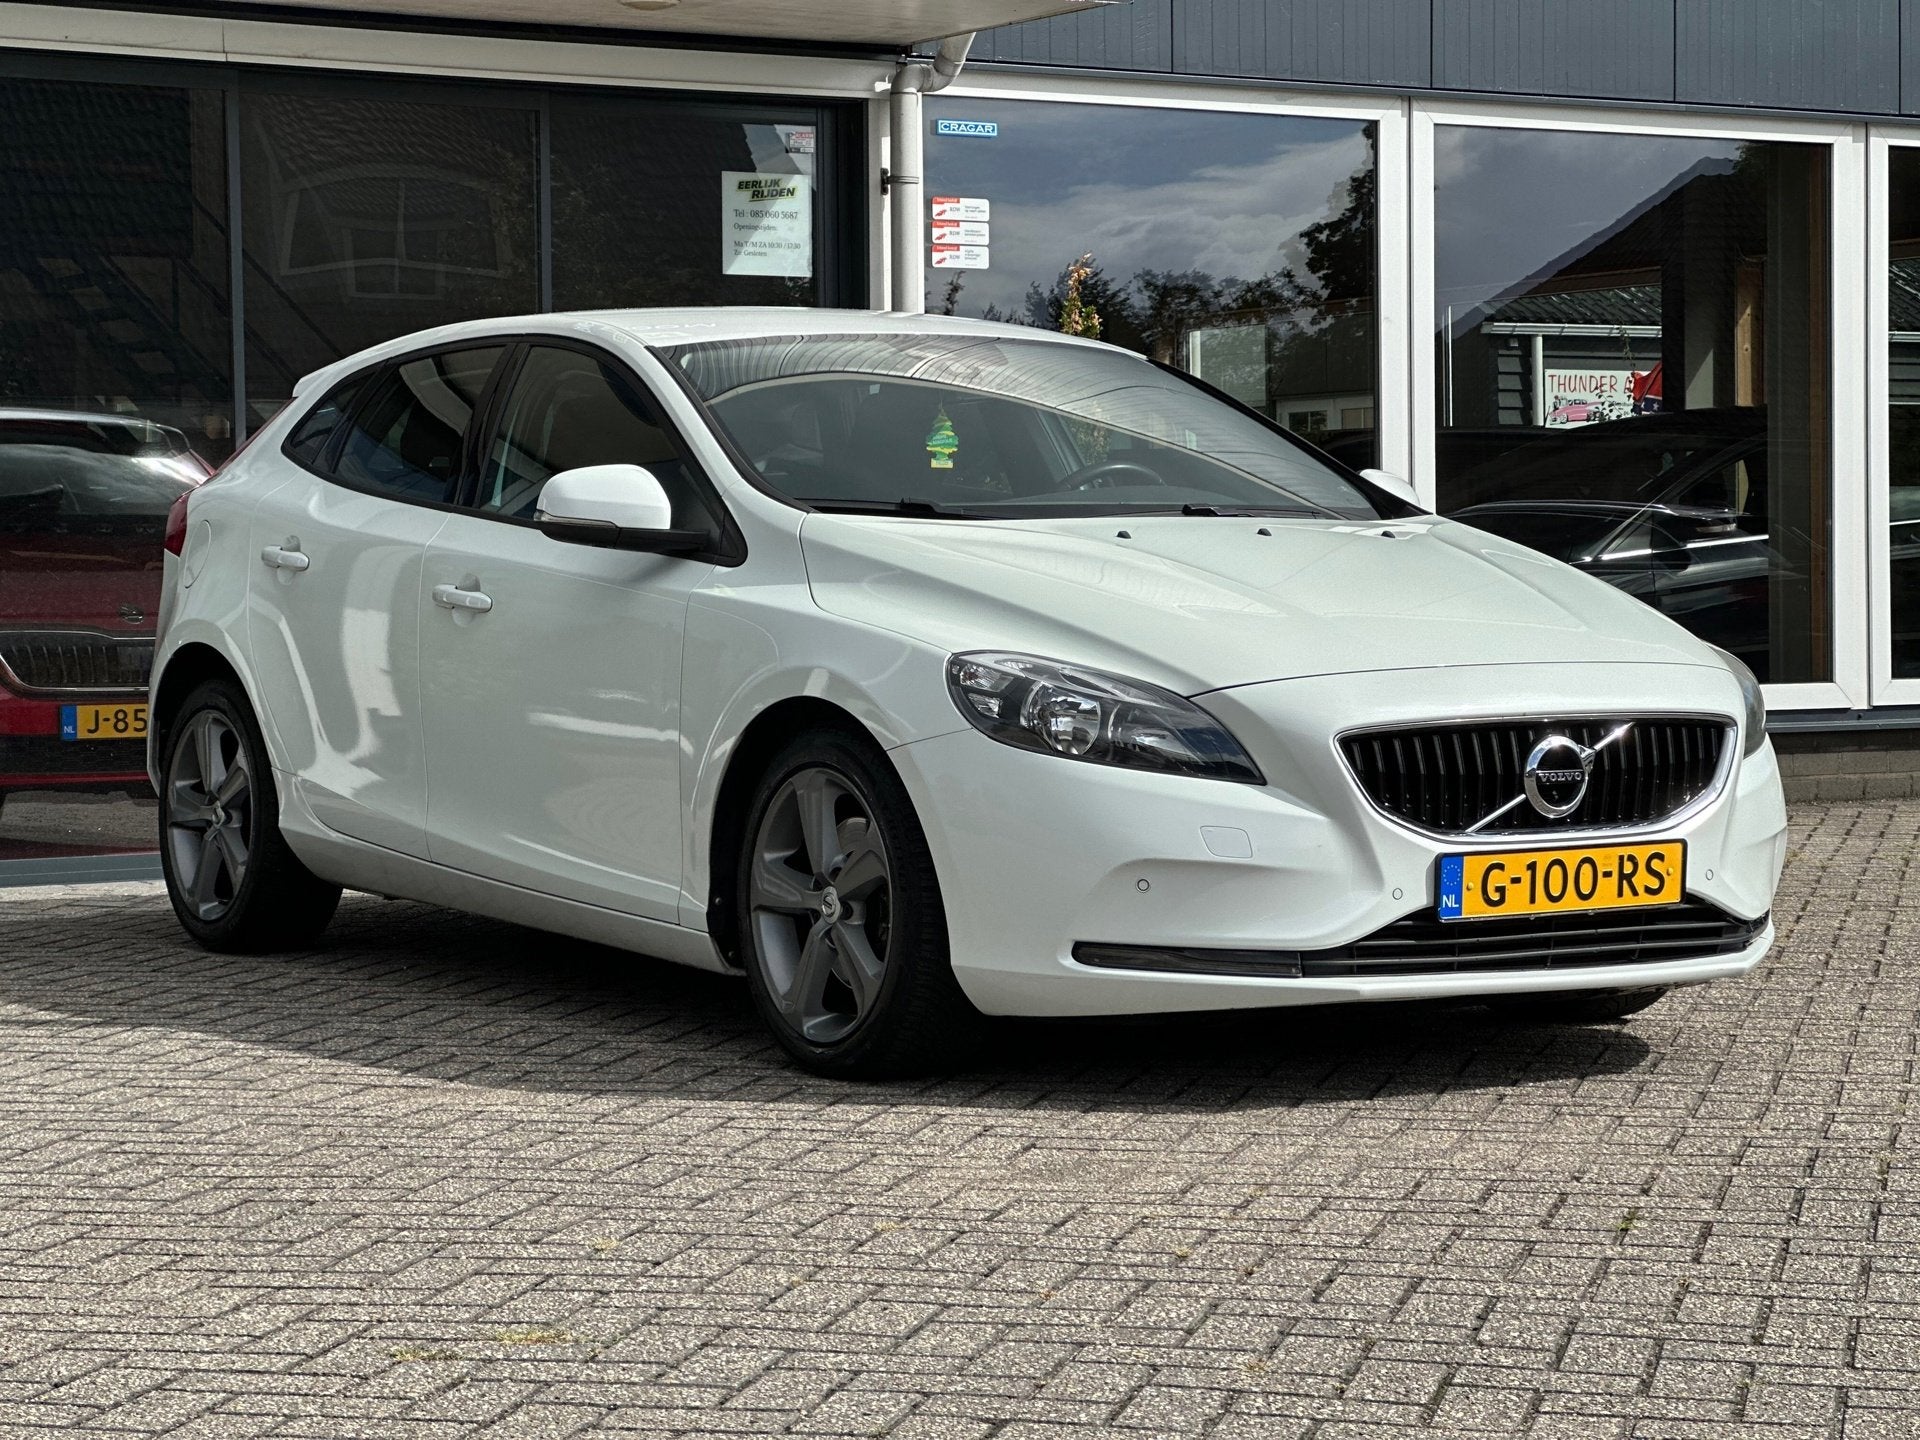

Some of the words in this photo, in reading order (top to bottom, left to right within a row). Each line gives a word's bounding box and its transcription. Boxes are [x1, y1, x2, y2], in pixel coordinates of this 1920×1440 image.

[941, 122, 994, 133] CRAGAR
[737, 179, 782, 190] EERLIJK
[751, 187, 796, 199] RIJDEN
[750, 210, 764, 219] 085
[781, 211, 798, 220] 5687
[1548, 374, 1618, 394] THUNDER
[63, 725, 75, 734] NL
[1539, 772, 1582, 782] VOLVO
[1442, 894, 1459, 908] NL
[1480, 851, 1666, 908] G-100-RS
